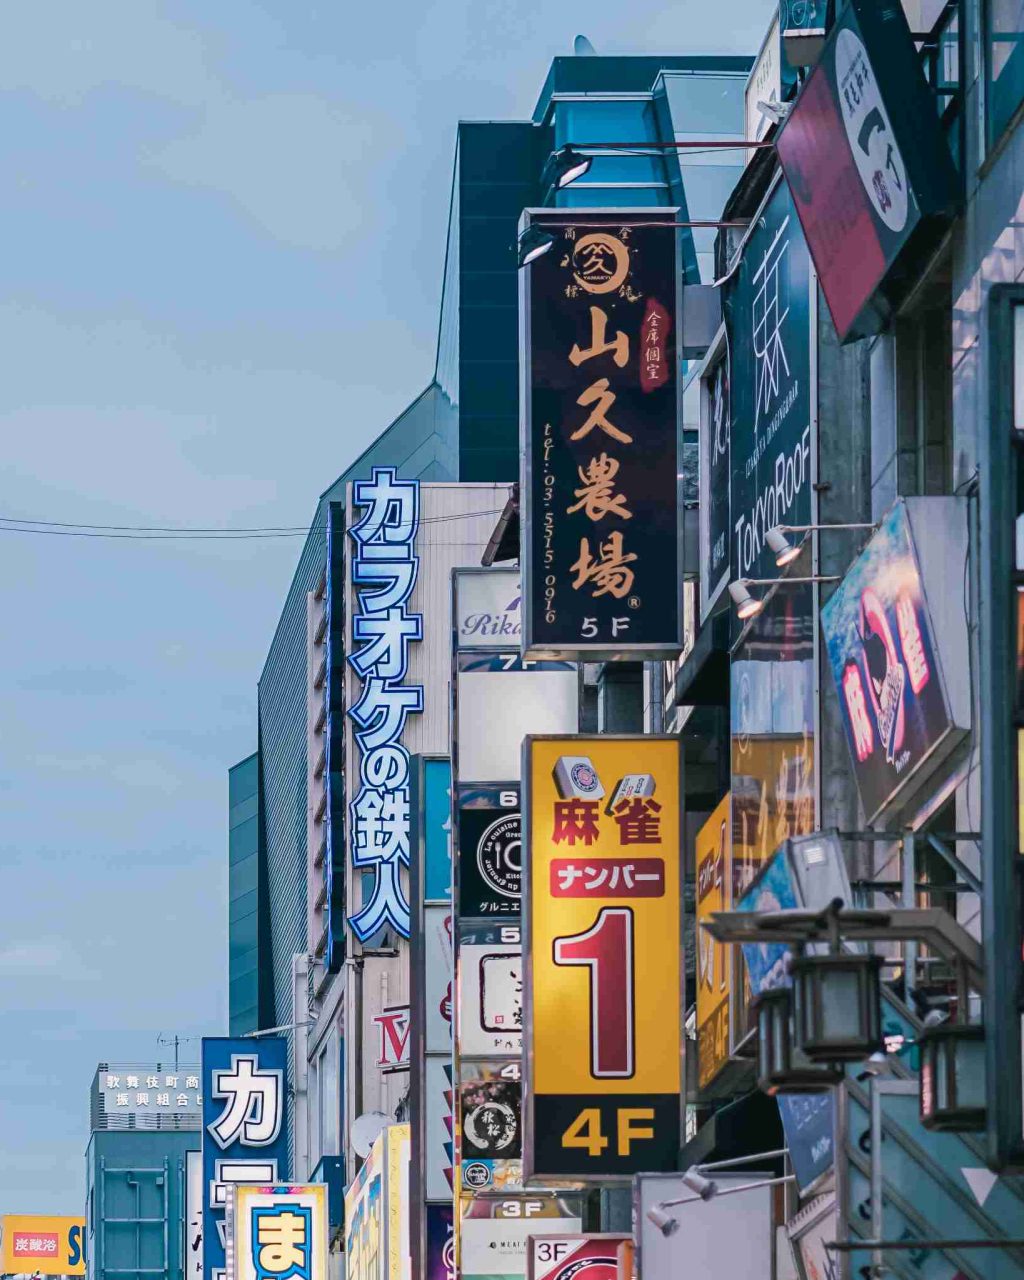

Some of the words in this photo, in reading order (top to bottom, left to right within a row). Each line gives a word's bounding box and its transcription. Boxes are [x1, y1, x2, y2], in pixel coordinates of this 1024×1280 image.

[567, 305, 638, 600] 山久農場
[580, 616, 631, 638] 5F
[348, 466, 424, 945] カラオケの鉄人
[551, 798, 662, 846] 麻雀
[557, 864, 660, 890] ナンバー
[552, 905, 635, 1080] 1
[561, 1107, 656, 1157] 4F
[502, 1201, 541, 1217] 3F
[537, 1243, 567, 1263] 3F
